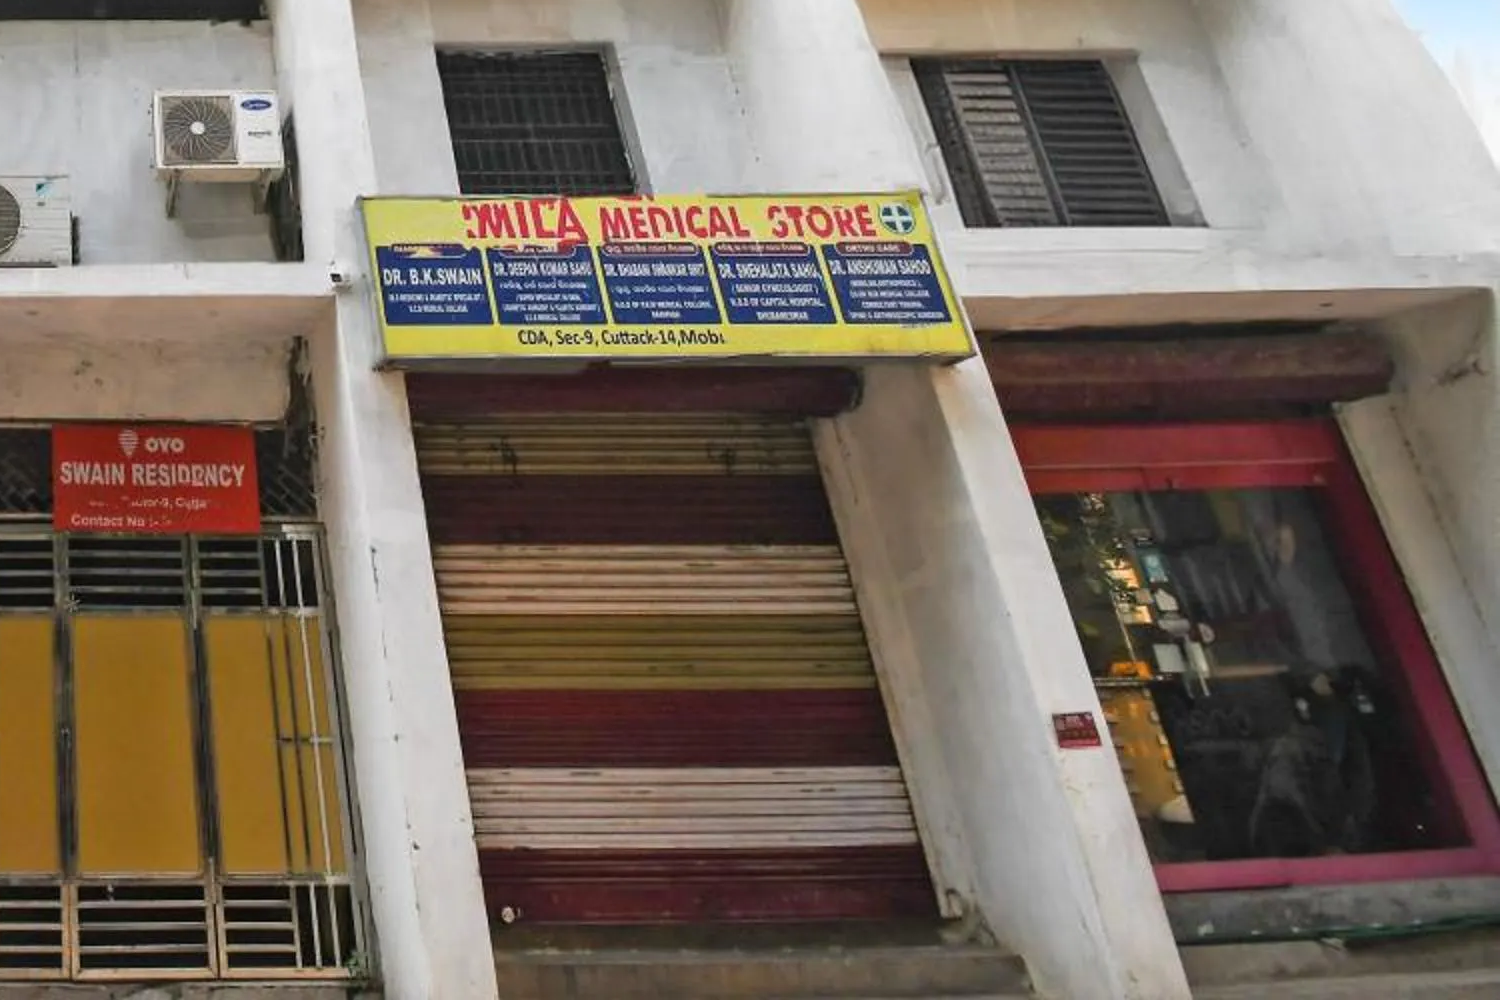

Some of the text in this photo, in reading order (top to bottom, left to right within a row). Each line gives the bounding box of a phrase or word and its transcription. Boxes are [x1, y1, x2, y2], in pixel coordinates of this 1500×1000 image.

[599, 205, 750, 240] MEDICAL
[767, 204, 877, 238] STORE
[383, 268, 407, 285] DR.
[518, 330, 553, 346] CDA,
[556, 329, 599, 346] Sec-9,
[145, 437, 185, 453] OYO
[60, 461, 125, 486] SWAIN
[71, 513, 123, 527] Contact
